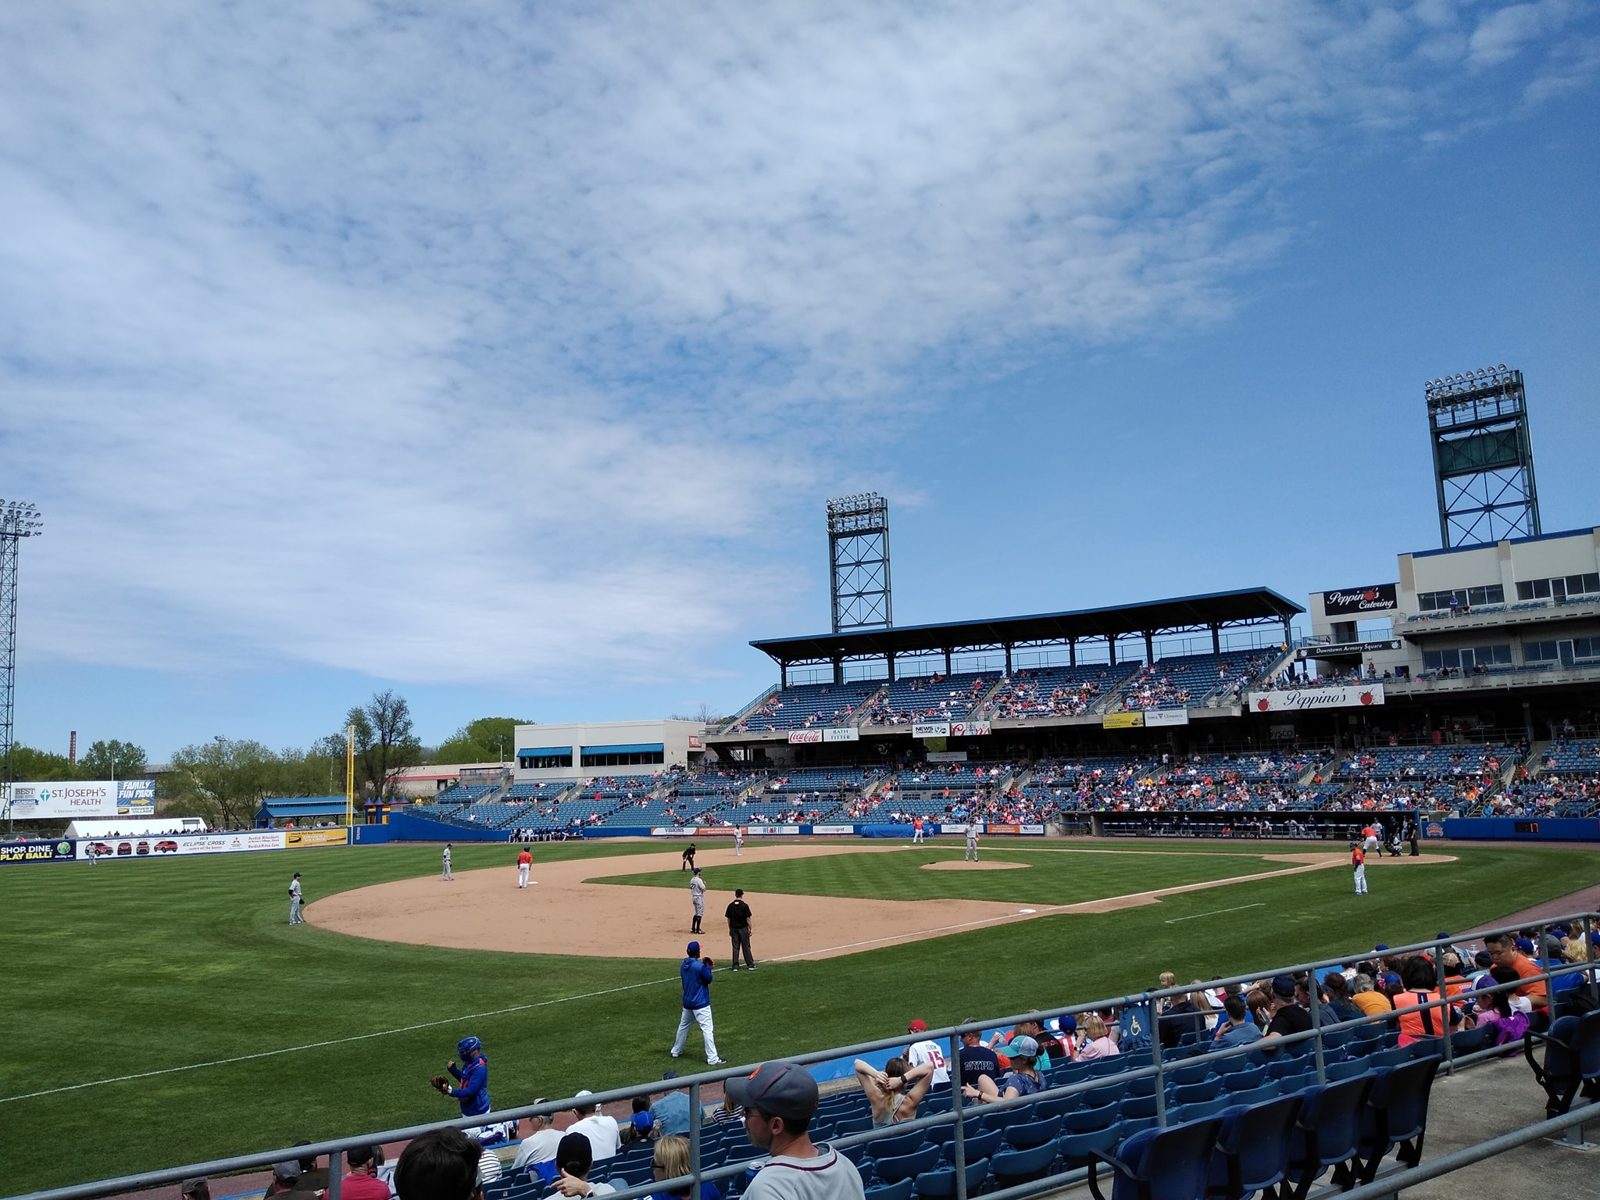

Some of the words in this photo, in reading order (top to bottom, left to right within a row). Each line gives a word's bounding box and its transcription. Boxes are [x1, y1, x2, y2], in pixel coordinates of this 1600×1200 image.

[1359, 598, 1394, 610] Catering
[1283, 688, 1346, 708] Peppino's
[123, 781, 151, 790] FAMILY
[64, 788, 106, 799] JOSEPH'S
[135, 790, 154, 798] PARK
[928, 1050, 944, 1070] 15
[964, 1060, 994, 1071] NYPD
